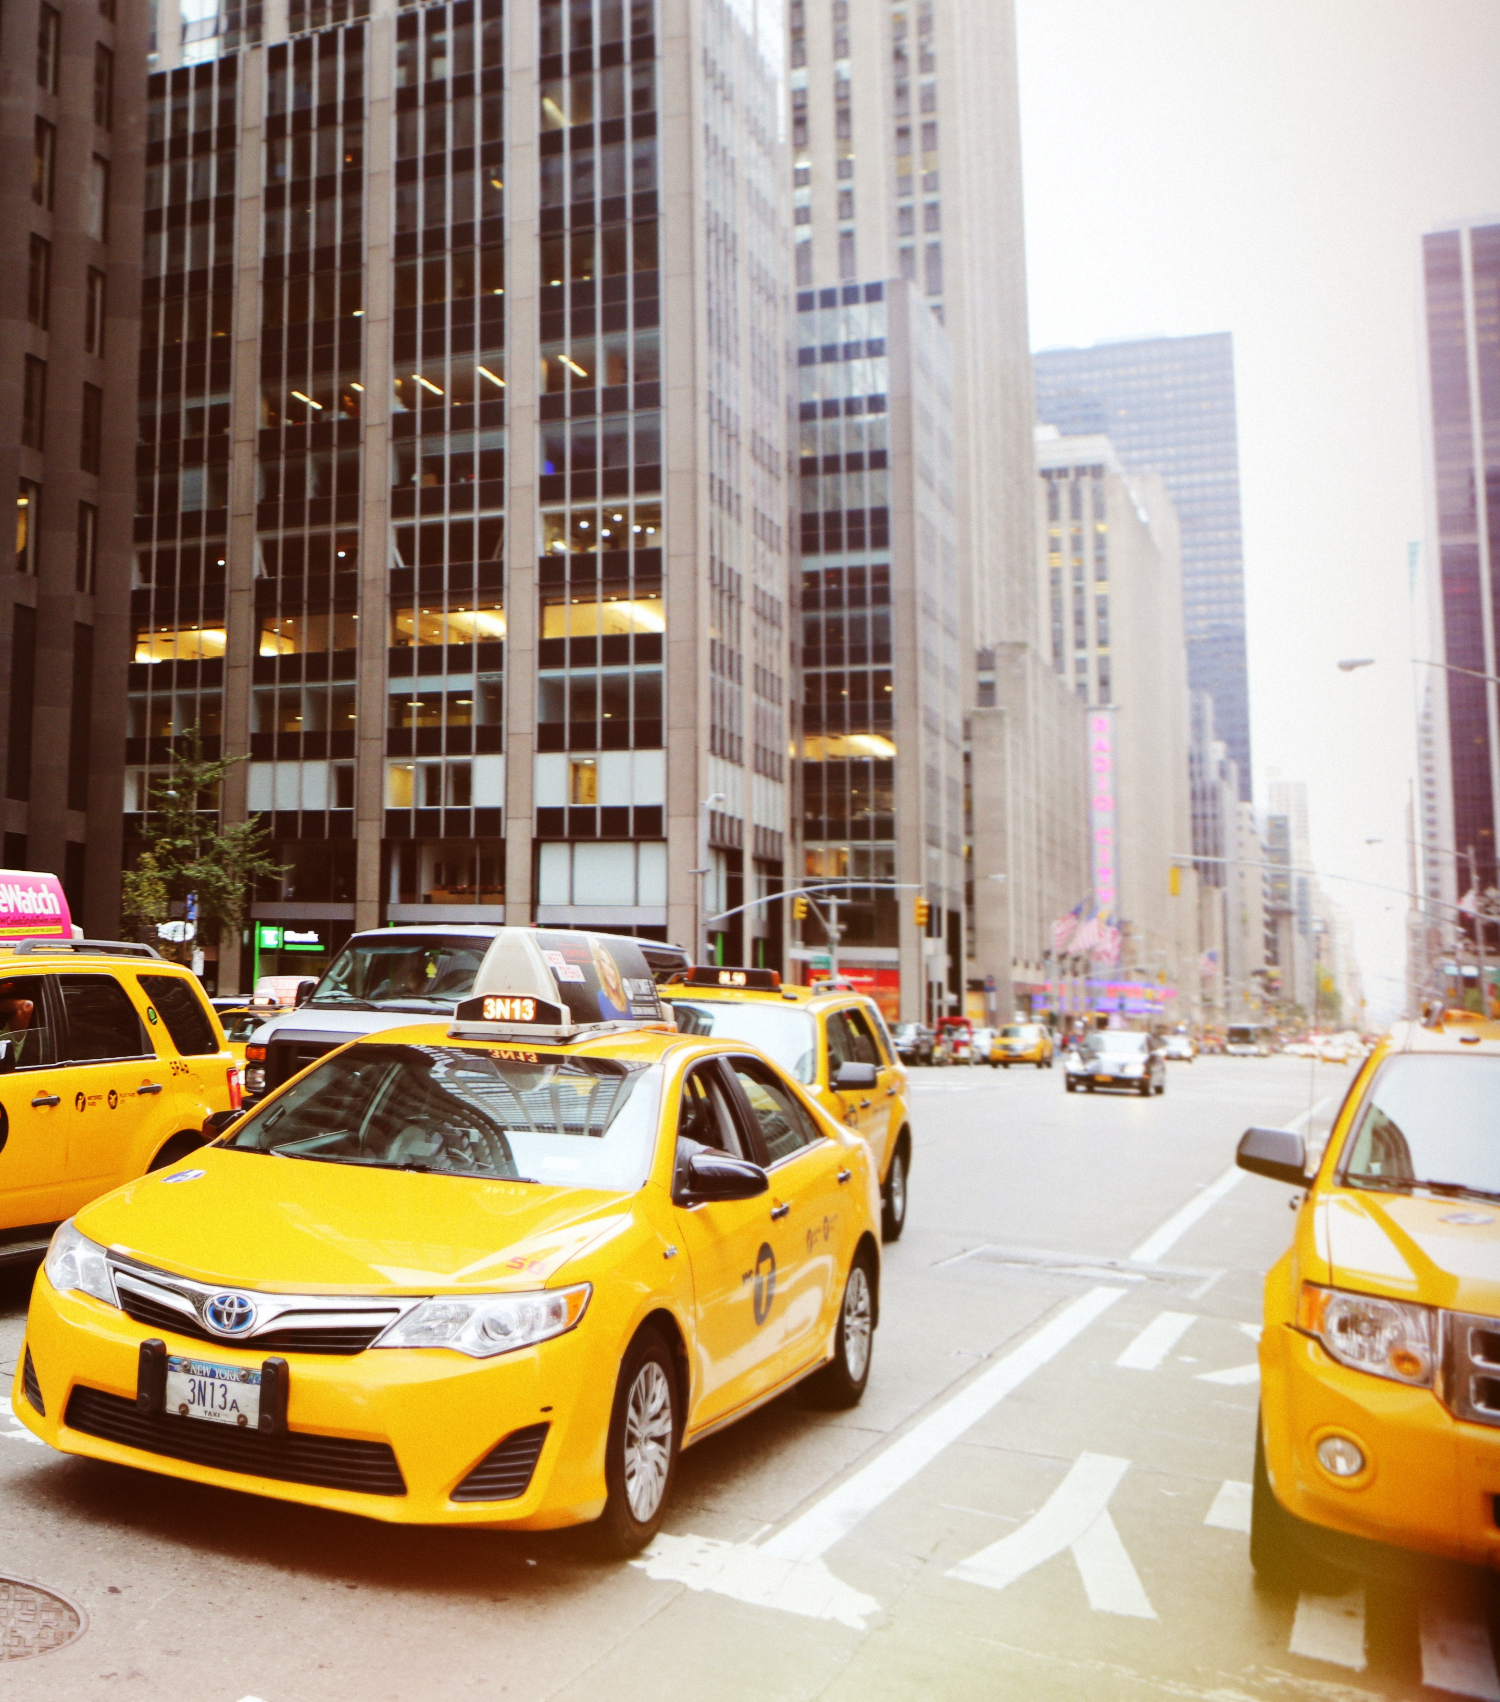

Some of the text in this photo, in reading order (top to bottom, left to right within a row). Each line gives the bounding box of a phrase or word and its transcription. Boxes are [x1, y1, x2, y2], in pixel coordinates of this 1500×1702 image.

[1092, 717, 1117, 904] RADIO CITY
[483, 998, 535, 1021] 3N13
[190, 1363, 241, 1381] NEW YORK
[204, 1410, 220, 1418] TAXI
